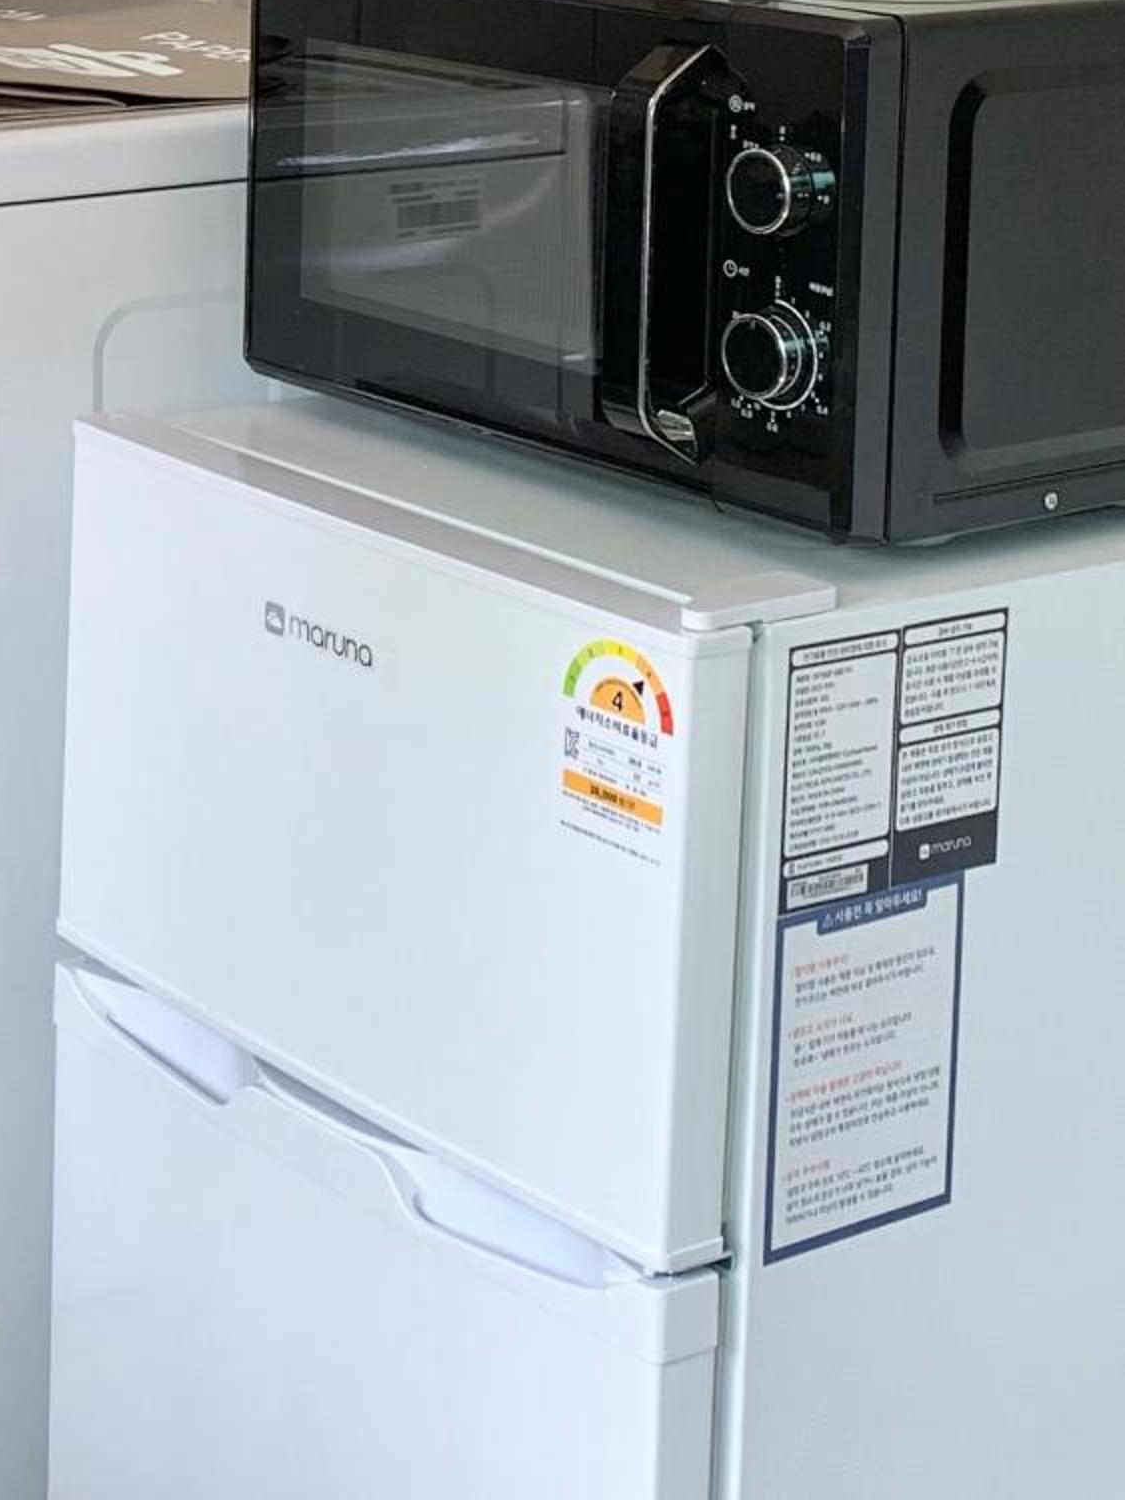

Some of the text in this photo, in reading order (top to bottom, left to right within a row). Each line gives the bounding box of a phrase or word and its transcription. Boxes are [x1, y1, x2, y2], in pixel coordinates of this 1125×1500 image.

[289, 614, 373, 667] maruna
[611, 690, 625, 713] 4
[932, 834, 972, 857] maruna
